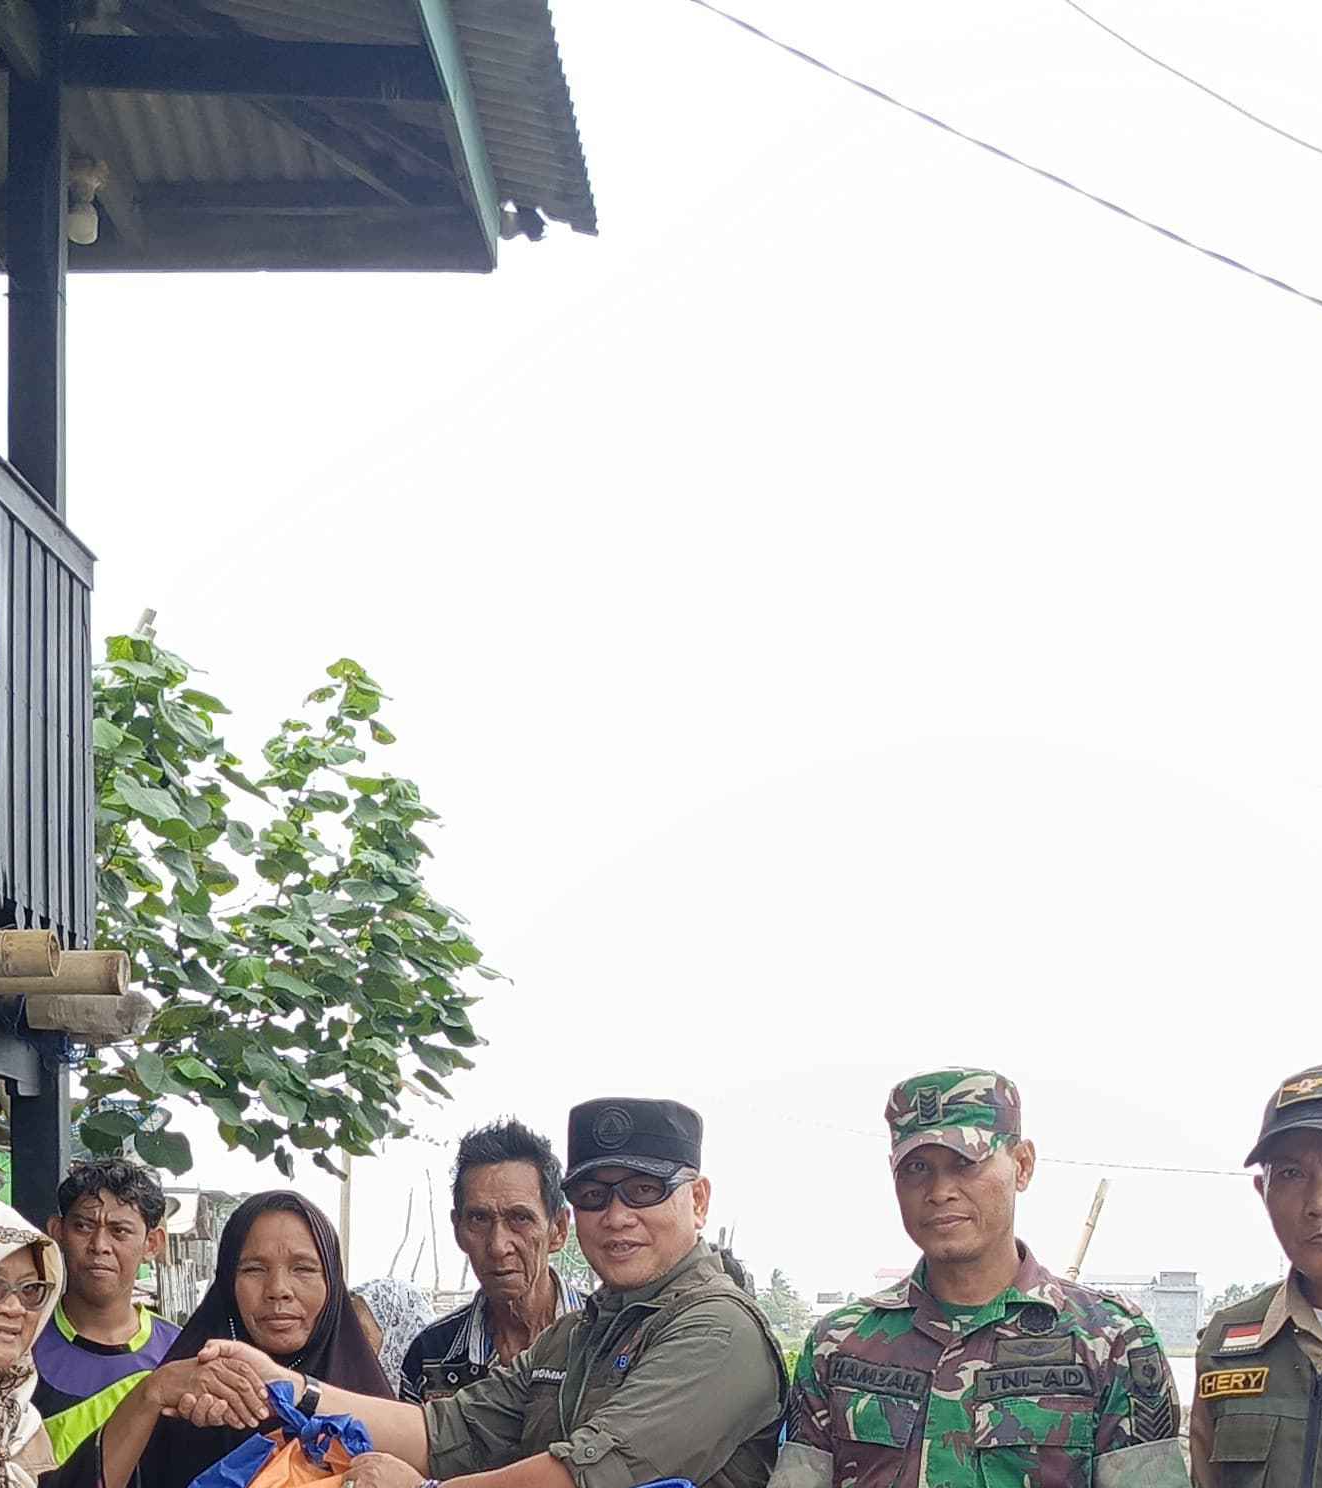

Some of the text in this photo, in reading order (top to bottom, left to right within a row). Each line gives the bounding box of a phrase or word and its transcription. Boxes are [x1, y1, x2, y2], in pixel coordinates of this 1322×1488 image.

[831, 1361, 921, 1392] HAMZAH
[985, 1368, 1084, 1392] TNI-AD
[1205, 1371, 1265, 1392] HERY
